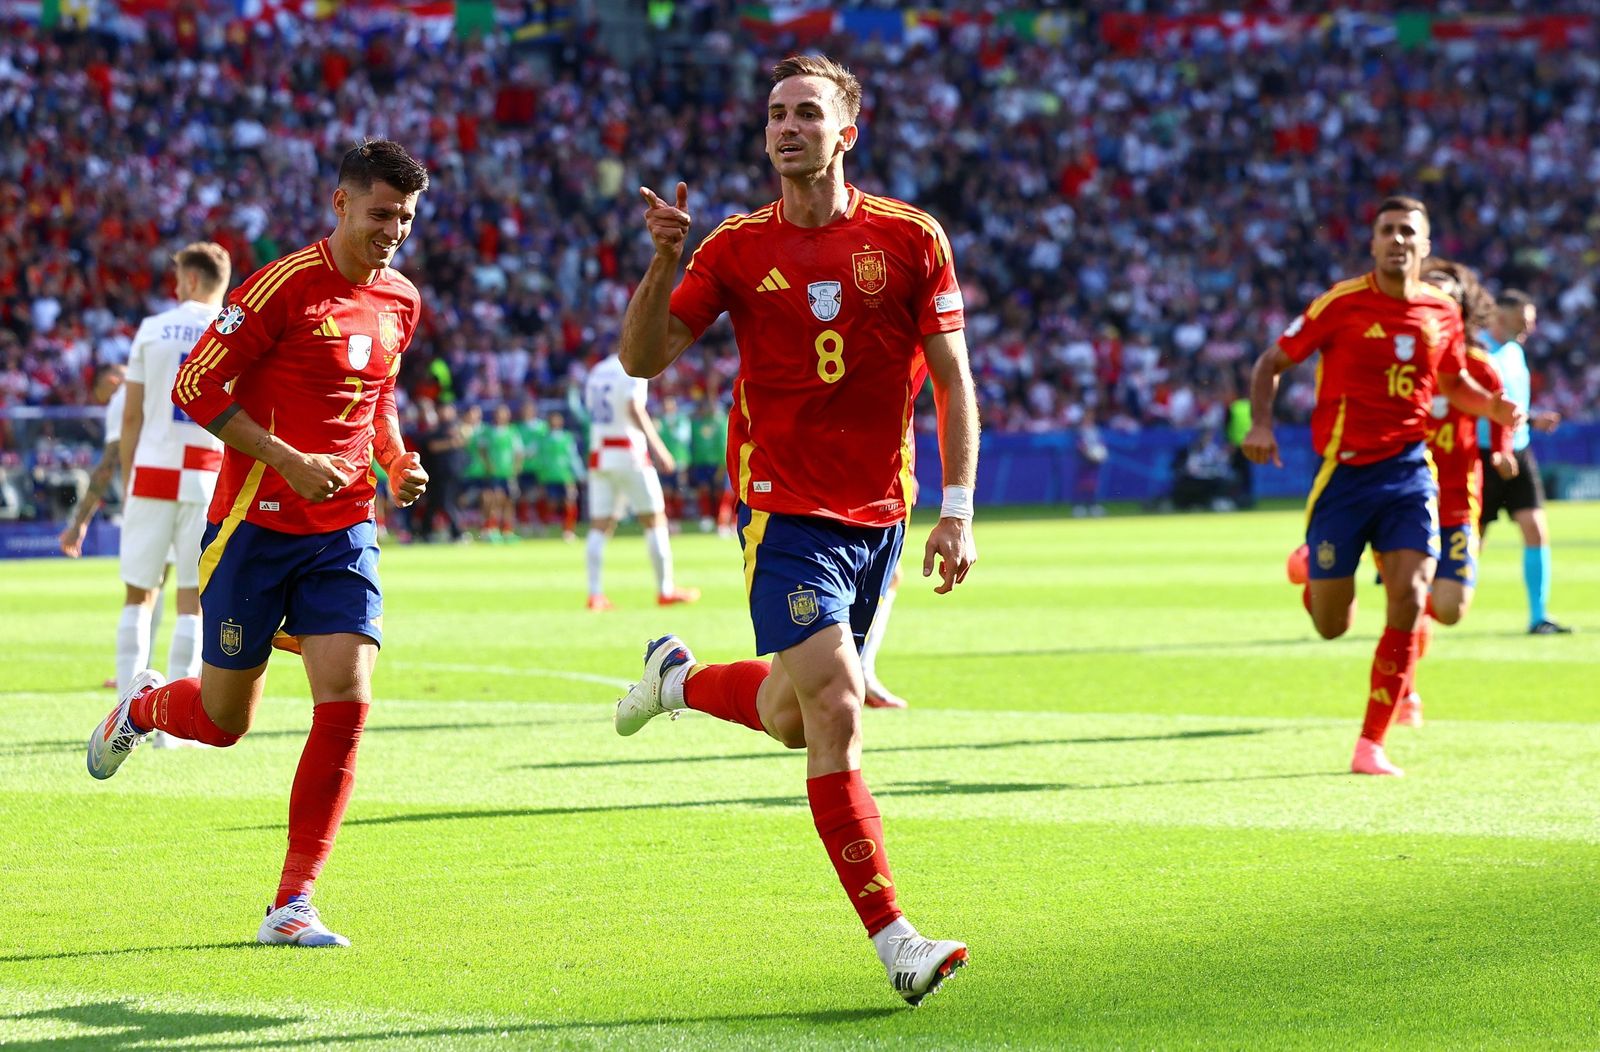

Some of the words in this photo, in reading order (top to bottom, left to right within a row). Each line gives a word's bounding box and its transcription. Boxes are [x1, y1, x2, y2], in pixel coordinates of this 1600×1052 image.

[815, 329, 846, 384] 8
[339, 376, 363, 421] 7
[1384, 363, 1416, 398] 16
